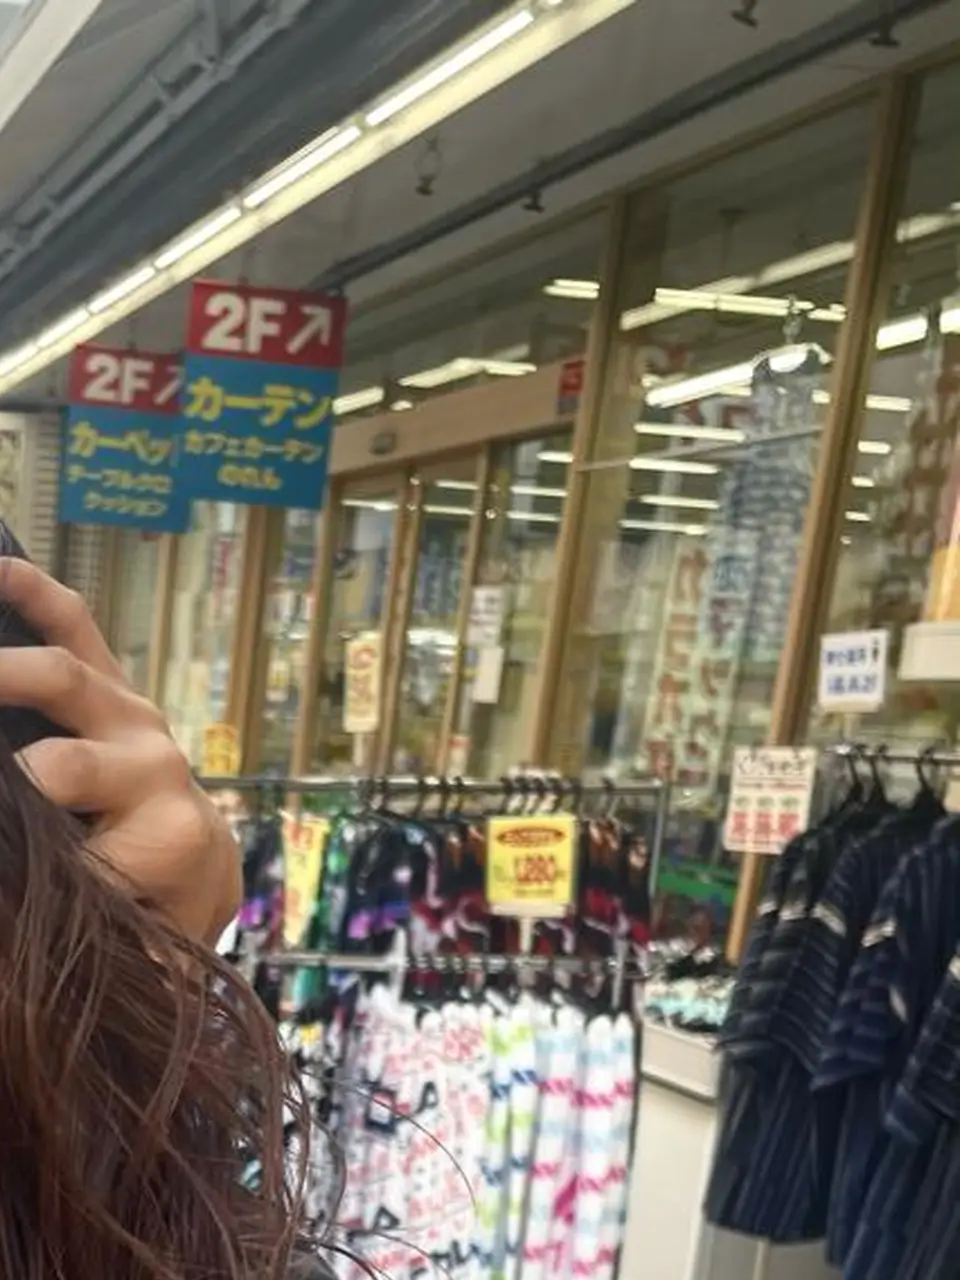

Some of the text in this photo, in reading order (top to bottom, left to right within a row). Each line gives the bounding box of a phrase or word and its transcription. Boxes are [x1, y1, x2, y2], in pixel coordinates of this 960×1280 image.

[201, 292, 286, 353] 2F
[80, 352, 154, 405] 2F
[184, 376, 333, 430] カーテン
